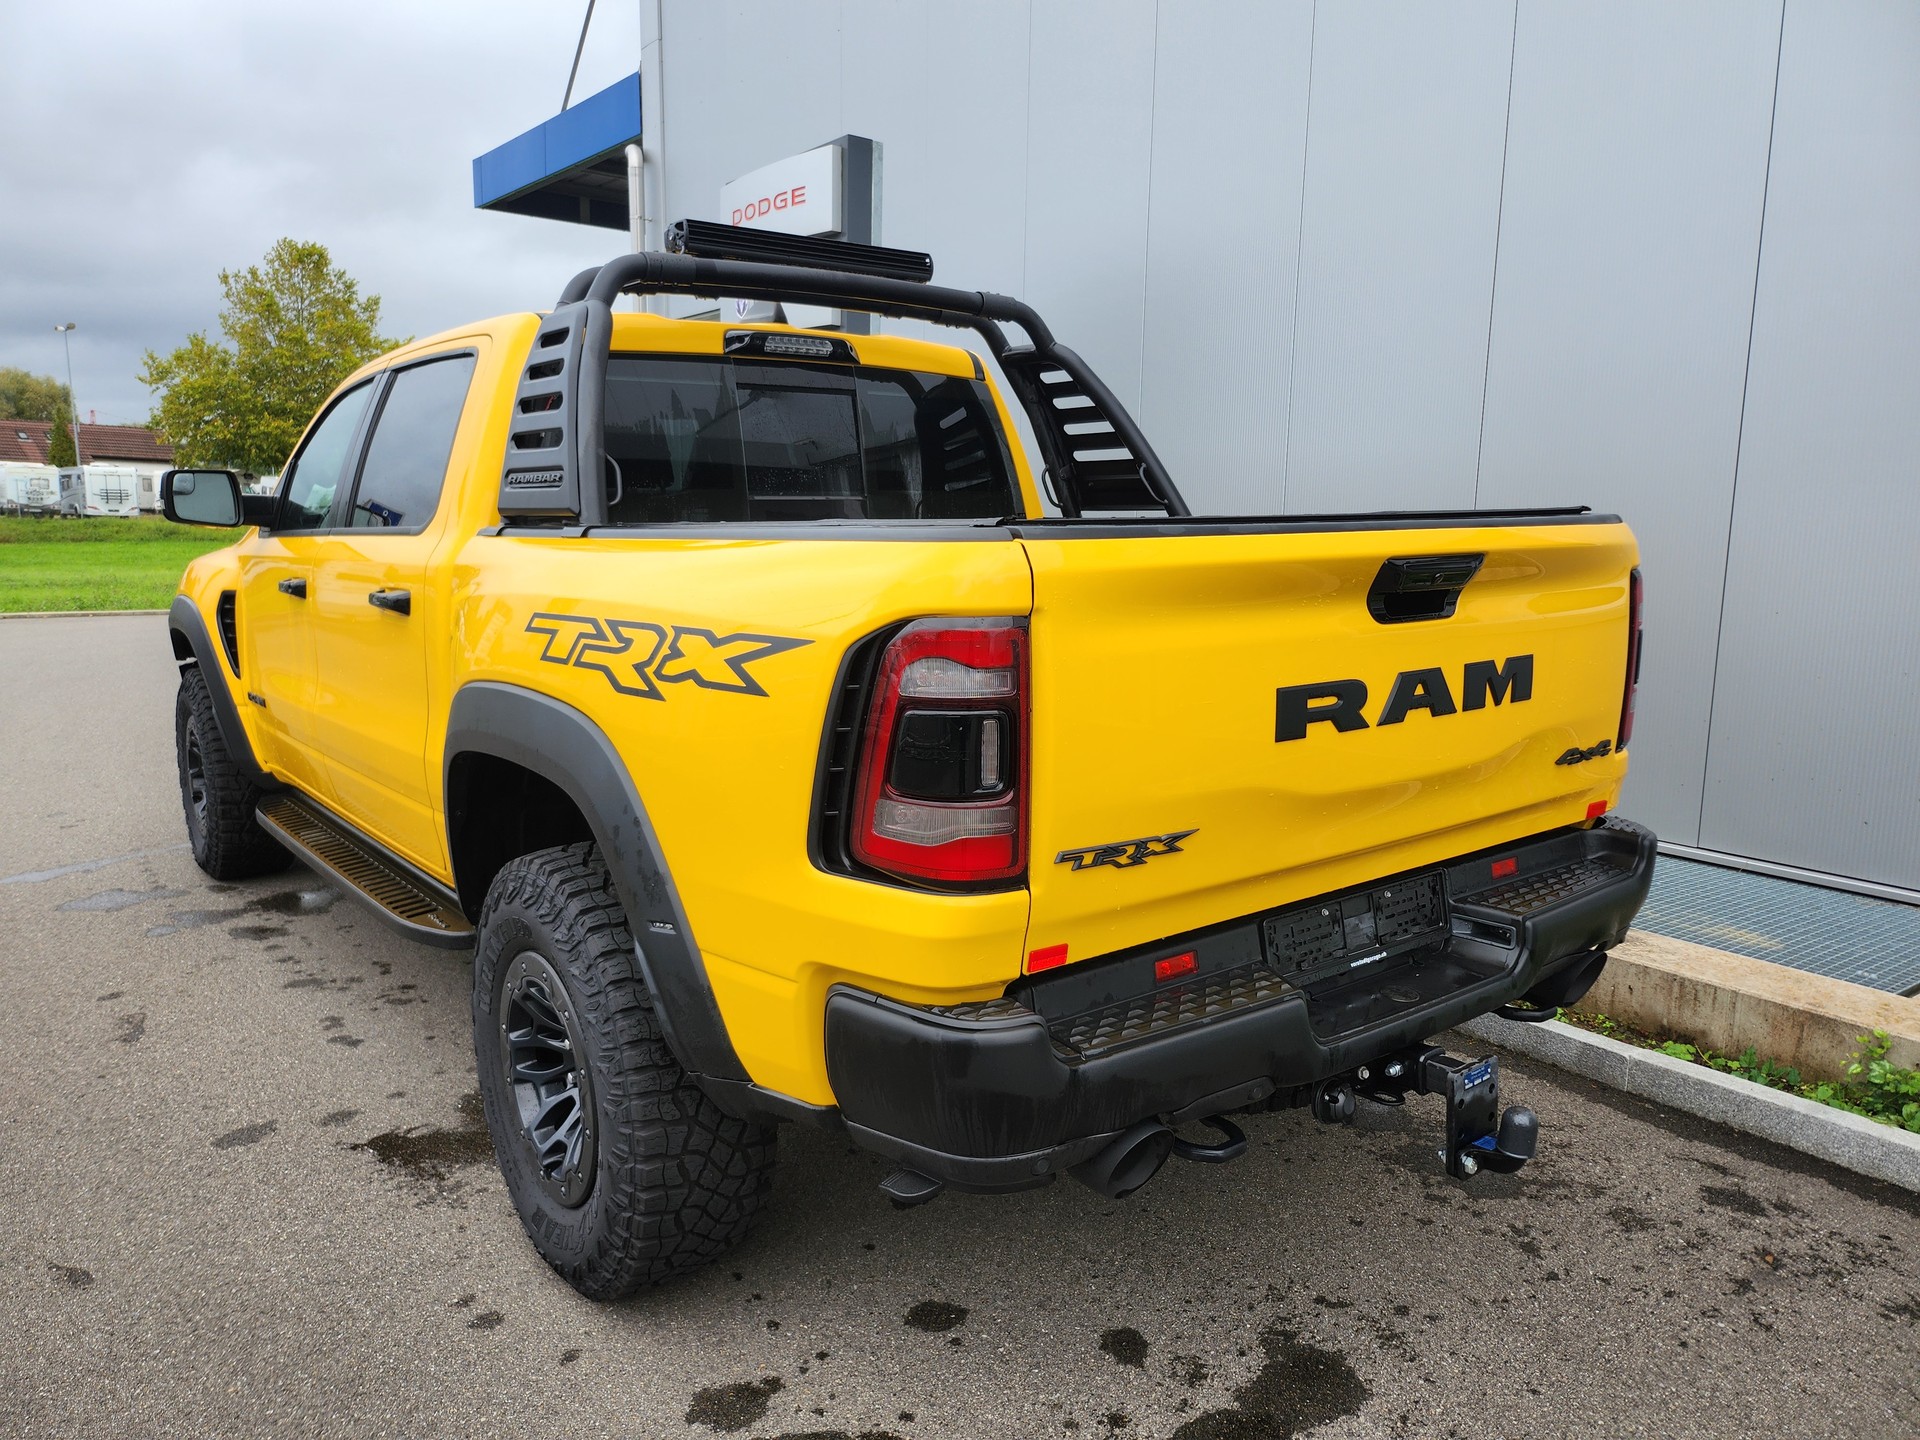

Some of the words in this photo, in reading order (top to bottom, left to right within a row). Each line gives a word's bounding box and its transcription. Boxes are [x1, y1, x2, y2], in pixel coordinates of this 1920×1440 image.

[732, 186, 806, 227] DODGE
[508, 473, 562, 485] RAMBAR
[524, 612, 816, 702] TRX
[1275, 654, 1534, 742] RAM
[1053, 828, 1200, 871] TRX
